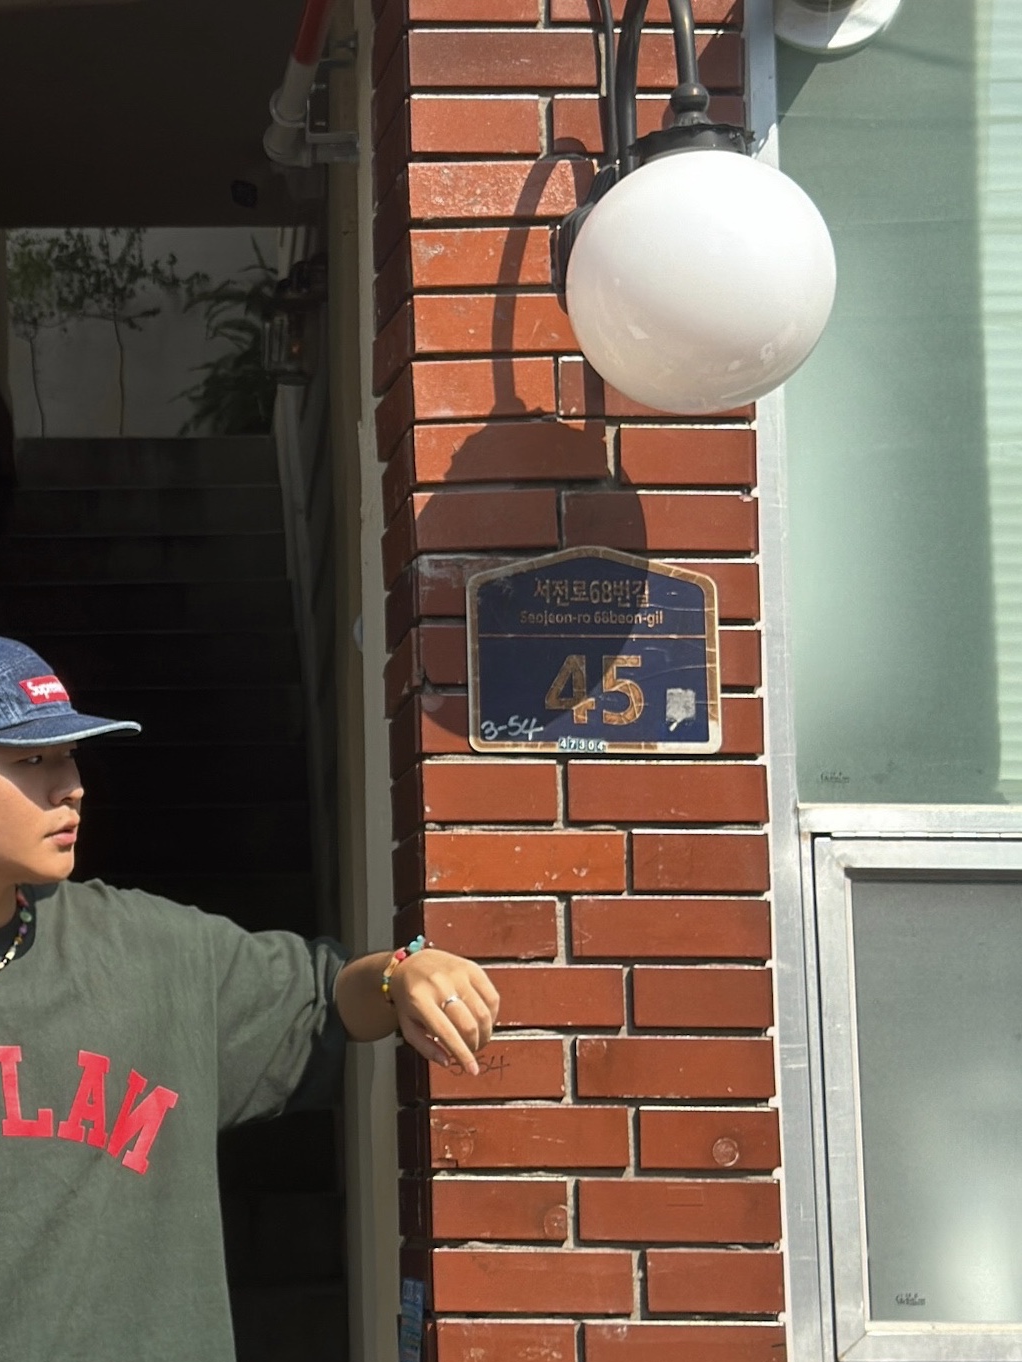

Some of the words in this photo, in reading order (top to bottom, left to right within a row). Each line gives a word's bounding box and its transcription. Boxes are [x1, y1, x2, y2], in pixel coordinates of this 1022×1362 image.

[533, 577, 650, 609] 서전로68번길
[519, 609, 591, 628] Seojeon-ro
[593, 609, 664, 629] 68beon-gil
[544, 654, 645, 727] 45
[480, 714, 544, 742] 3-54
[559, 738, 605, 751] 47304
